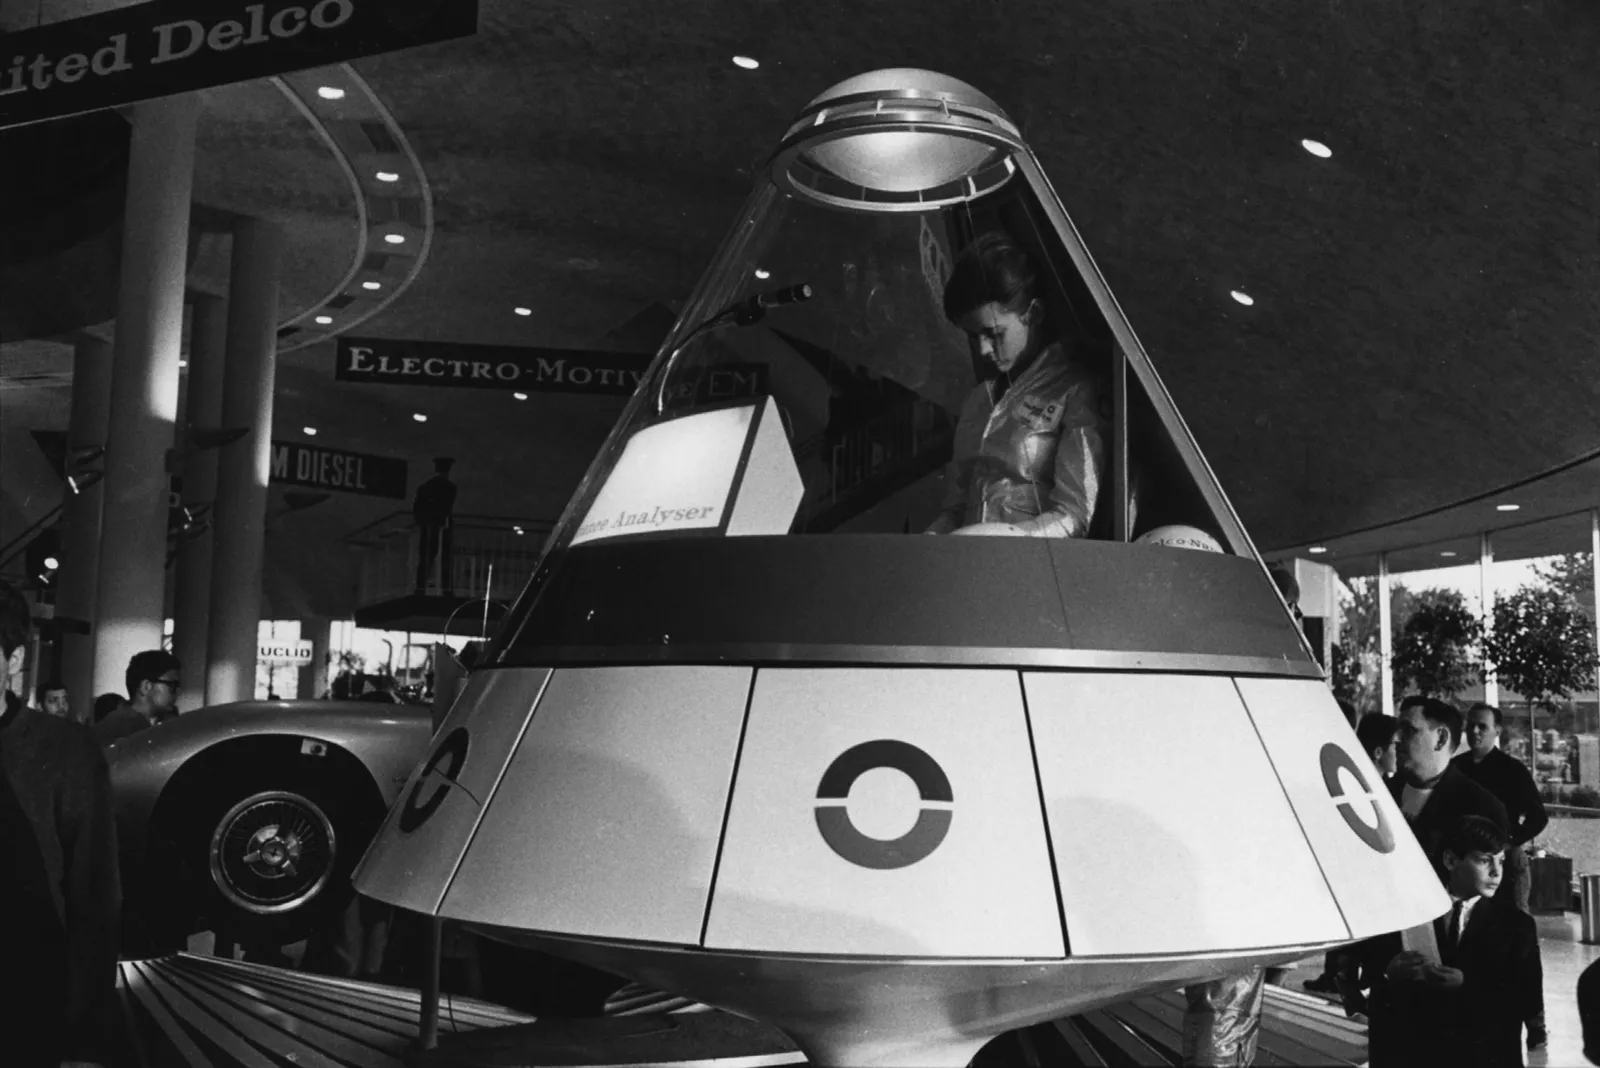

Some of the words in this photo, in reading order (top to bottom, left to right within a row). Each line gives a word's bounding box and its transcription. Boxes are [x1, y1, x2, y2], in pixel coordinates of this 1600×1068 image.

[0, 33, 133, 96] ited
[150, 0, 354, 65] Delco
[297, 447, 366, 490] DIESEL
[610, 504, 714, 529] Analyser
